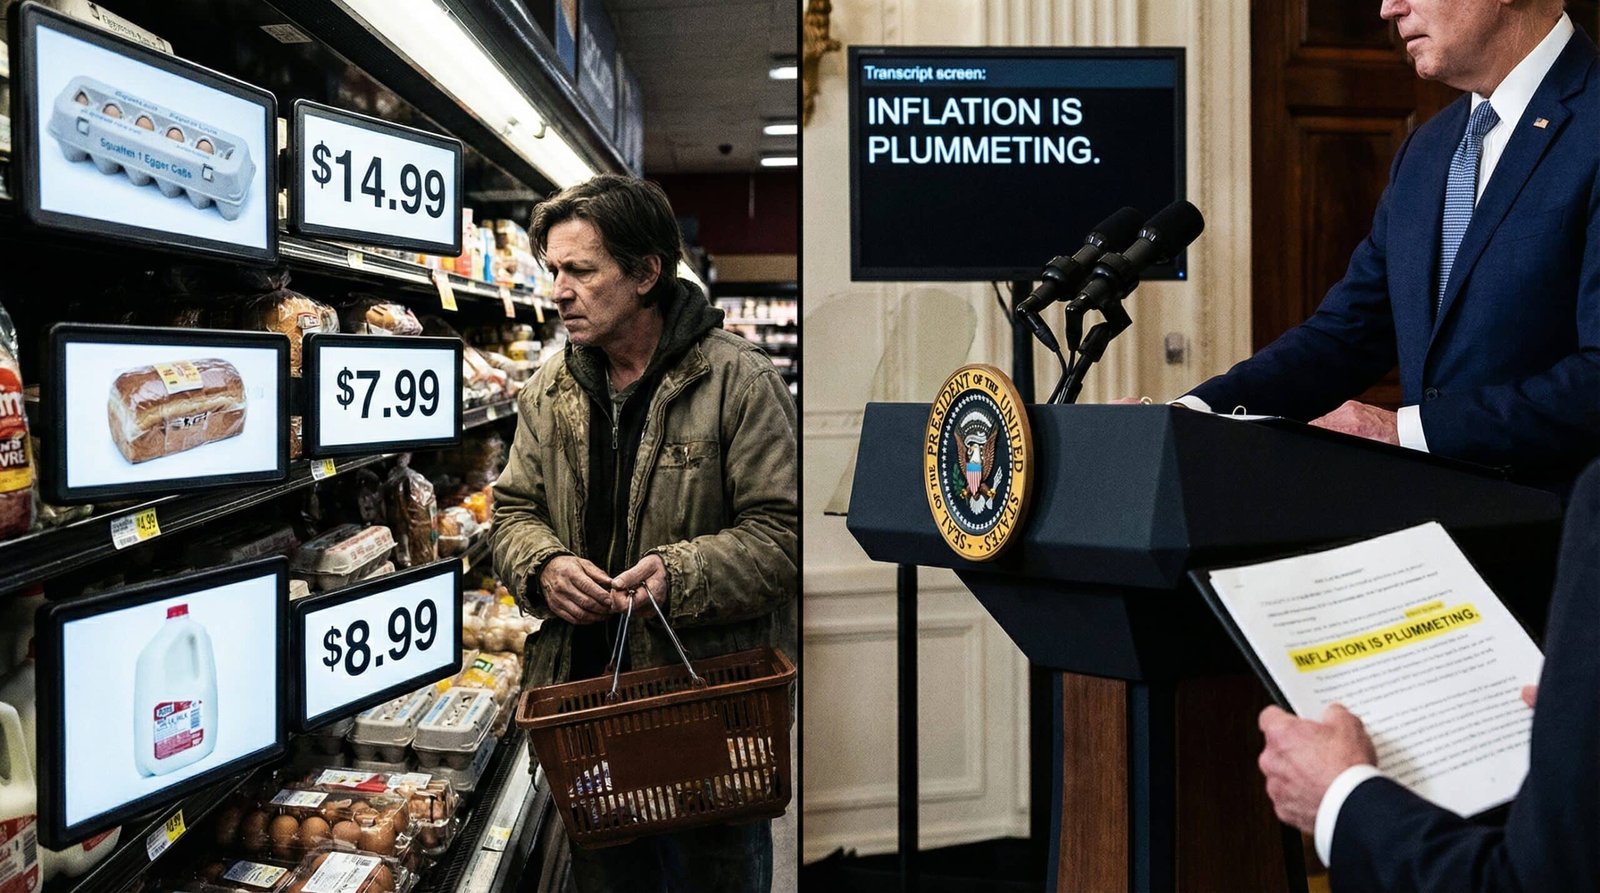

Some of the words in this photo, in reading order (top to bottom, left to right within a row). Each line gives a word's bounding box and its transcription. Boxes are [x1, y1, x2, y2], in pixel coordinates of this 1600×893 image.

[864, 65, 934, 83] Transcript
[936, 68, 987, 80] screen:
[868, 97, 1041, 126] INFLATION
[1052, 98, 1083, 126] IS
[868, 136, 1101, 165] PLUMMETING.
[311, 140, 446, 219] $14.99
[336, 366, 440, 419] $7.99
[972, 374, 984, 386] OF
[984, 376, 999, 396] THE
[927, 372, 970, 457] PRESIDENT
[1000, 394, 1024, 473] UNITED
[928, 465, 938, 490] THE
[932, 494, 942, 510] OF
[984, 492, 1020, 552] STATES
[941, 510, 967, 550] SEAL
[322, 599, 438, 677] $8.99
[1294, 641, 1368, 667] INFLATION
[1368, 636, 1384, 650] IS
[1384, 608, 1480, 645] PLUMMETING.
